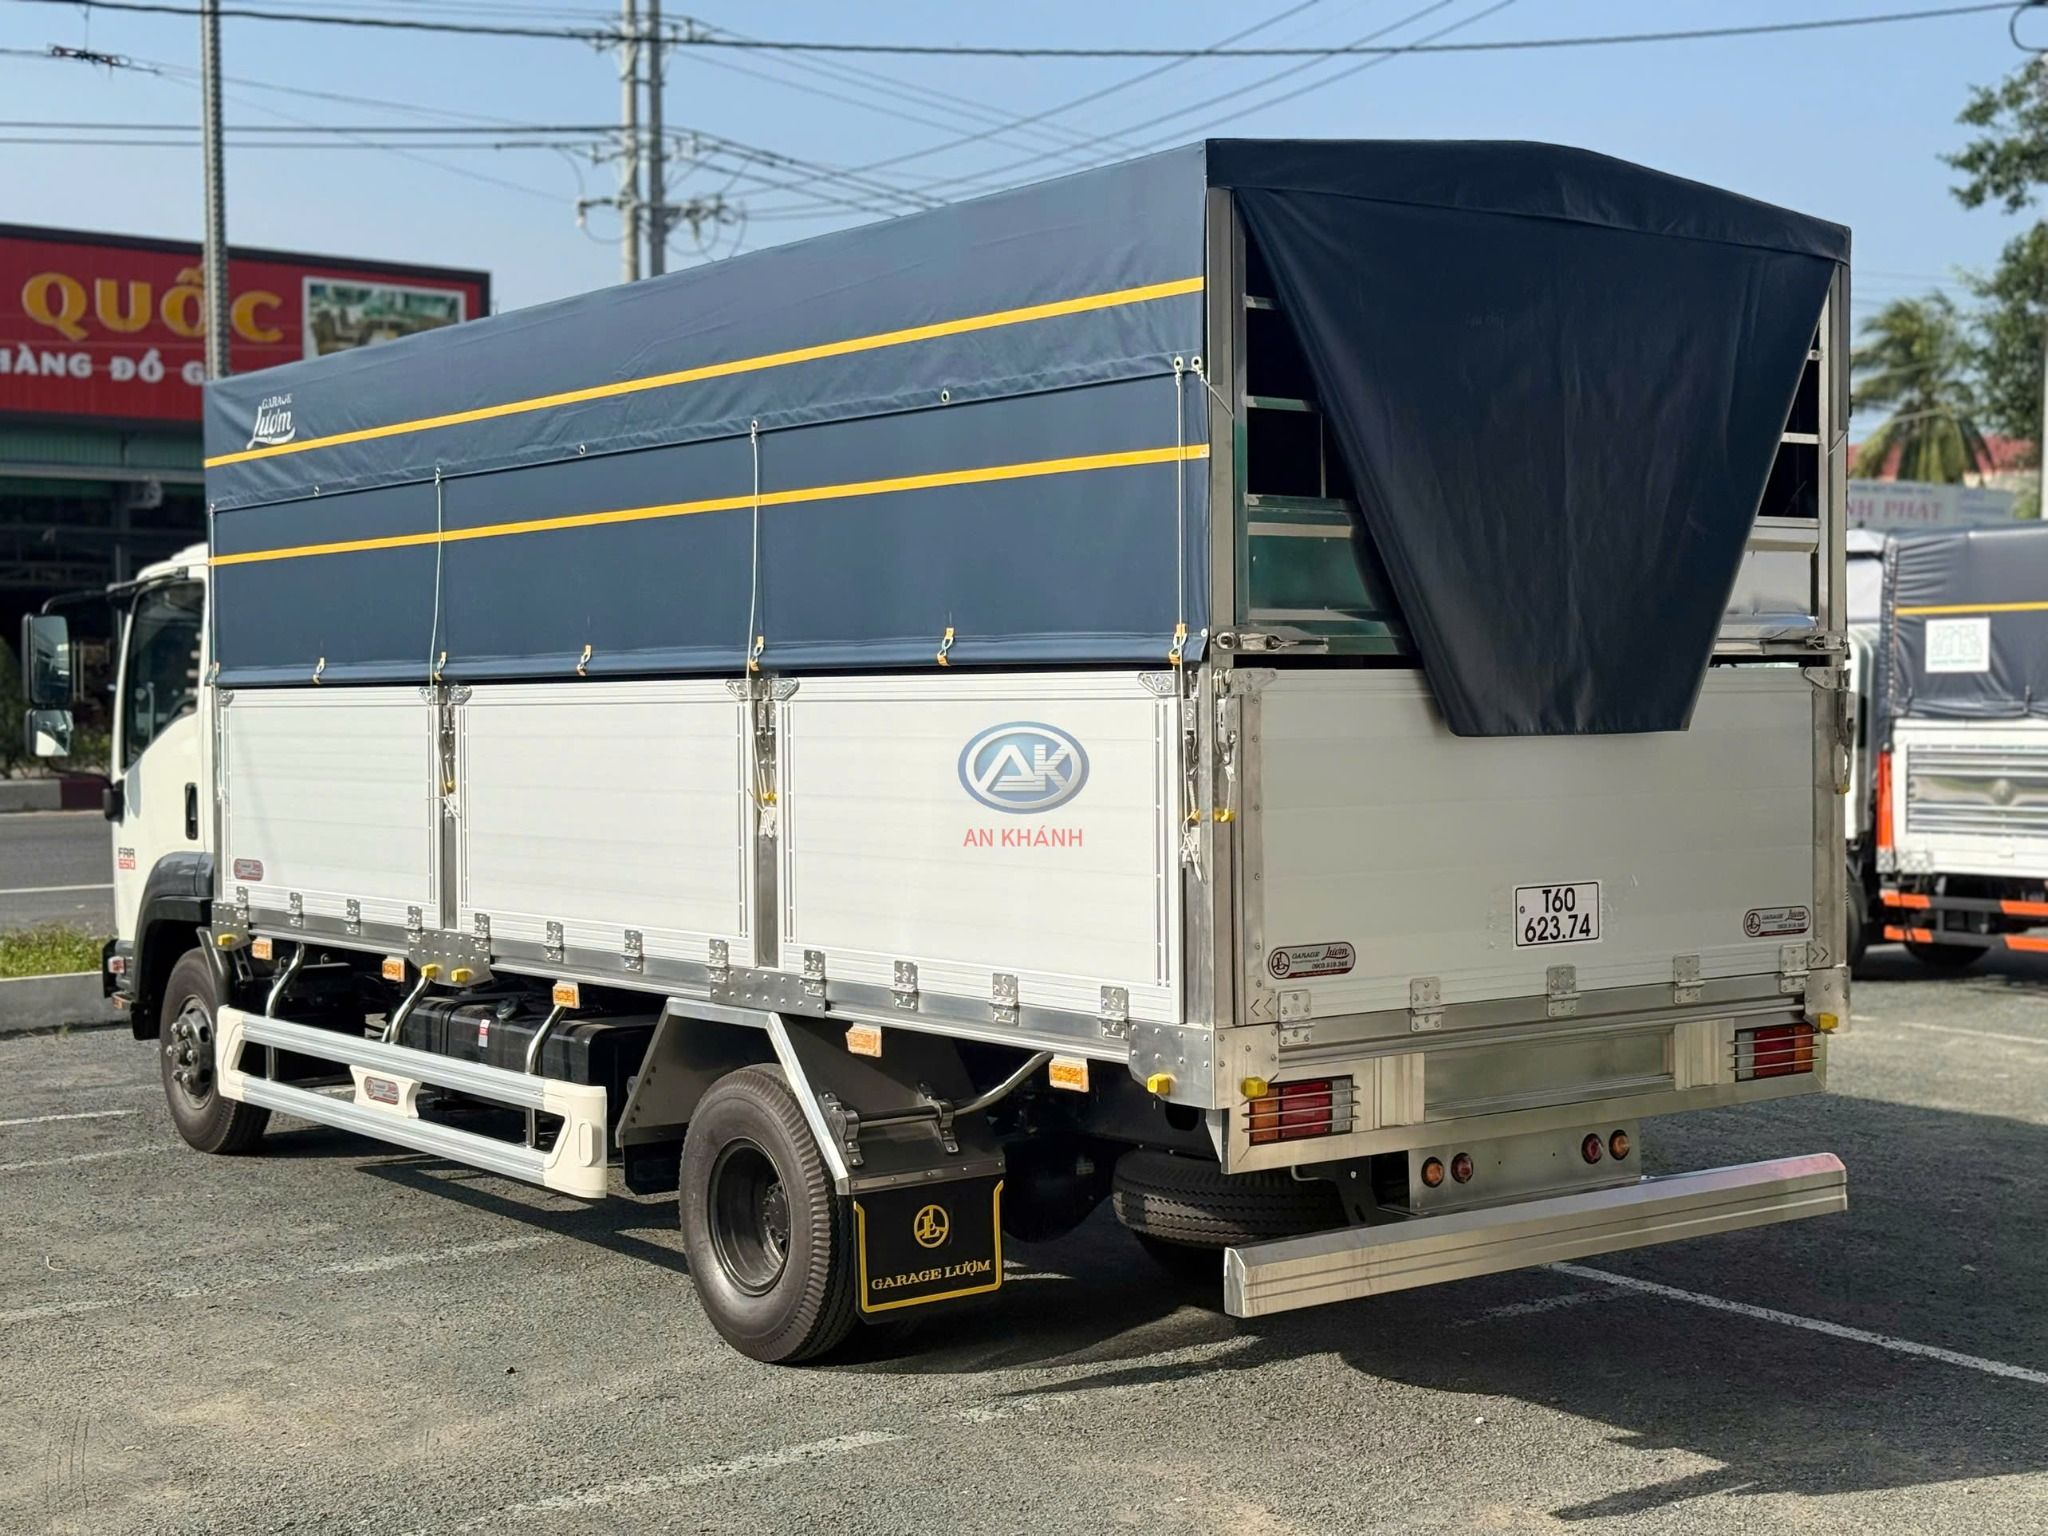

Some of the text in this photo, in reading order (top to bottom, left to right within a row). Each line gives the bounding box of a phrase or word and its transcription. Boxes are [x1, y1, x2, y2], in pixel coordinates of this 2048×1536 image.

[1542, 887, 1576, 914] T60
[1525, 912, 1591, 943] 623.74
[871, 1259, 992, 1291] GARAGE LƯỢM
